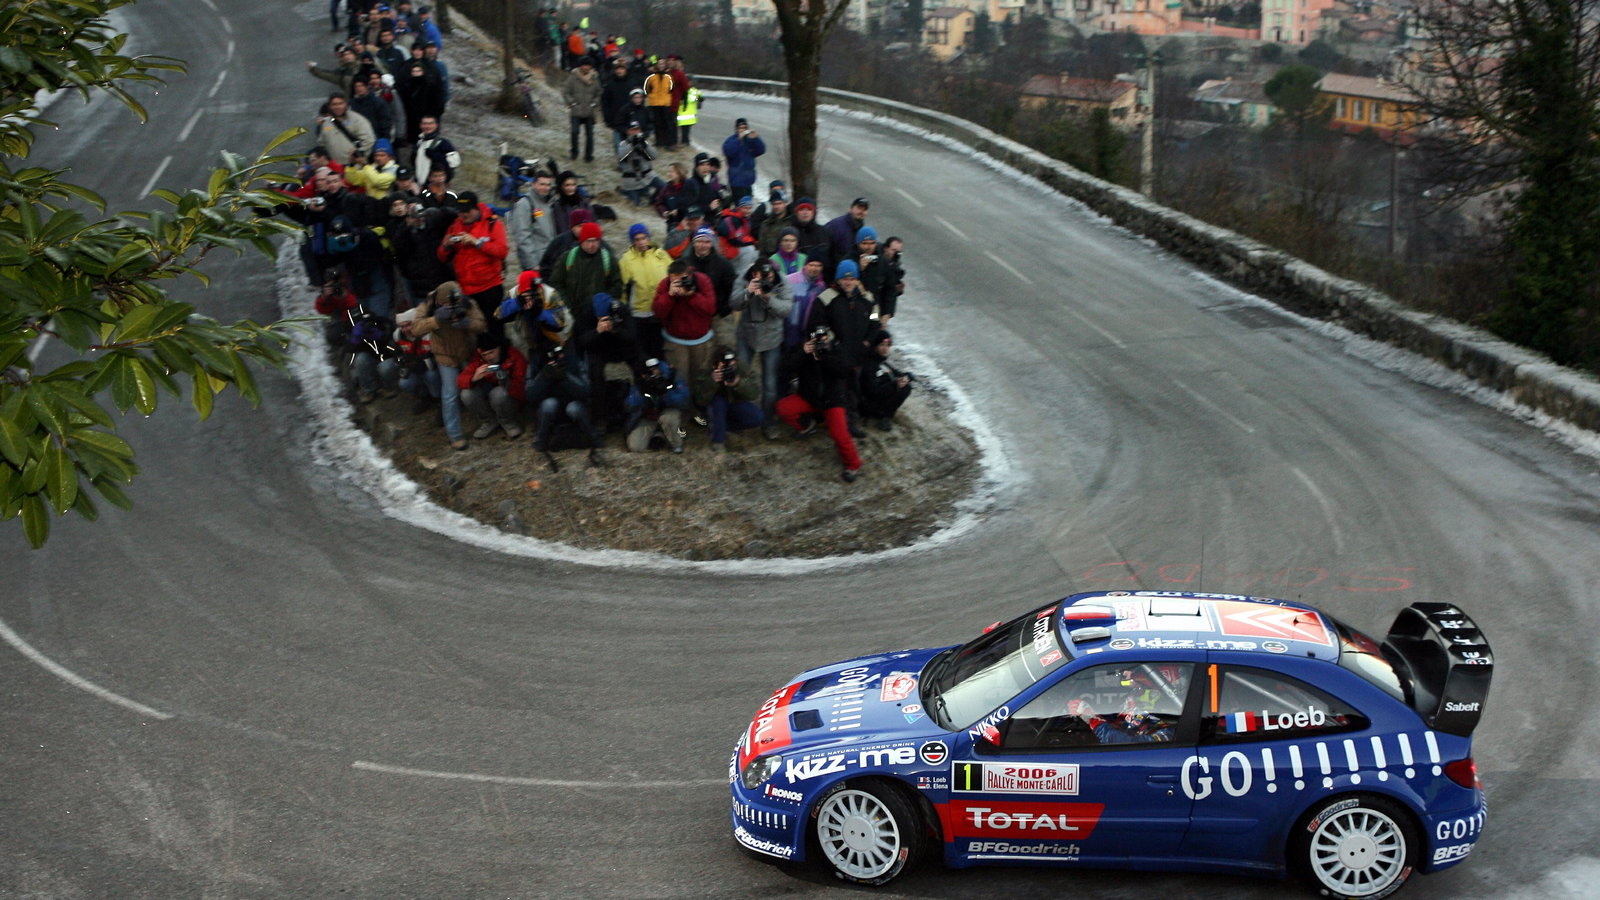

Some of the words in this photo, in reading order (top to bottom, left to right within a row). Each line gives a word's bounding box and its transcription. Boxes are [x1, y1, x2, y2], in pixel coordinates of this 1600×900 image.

[1207, 664, 1218, 712] 1
[755, 687, 788, 743] TOTAL
[1262, 705, 1325, 731] Loeb
[1445, 701, 1480, 712] Sabelt
[968, 705, 1010, 741] NIKKO
[827, 748, 859, 756] NATURAL
[861, 743, 890, 751] ENERGY
[785, 747, 916, 784] kizz-me
[963, 763, 971, 790] 1
[1004, 767, 1057, 779] 2006
[987, 770, 1014, 789] RALLYE
[966, 807, 1079, 831] TOTAL
[734, 825, 793, 857] BFGoodrich
[968, 841, 1080, 855] BFGoodrich
